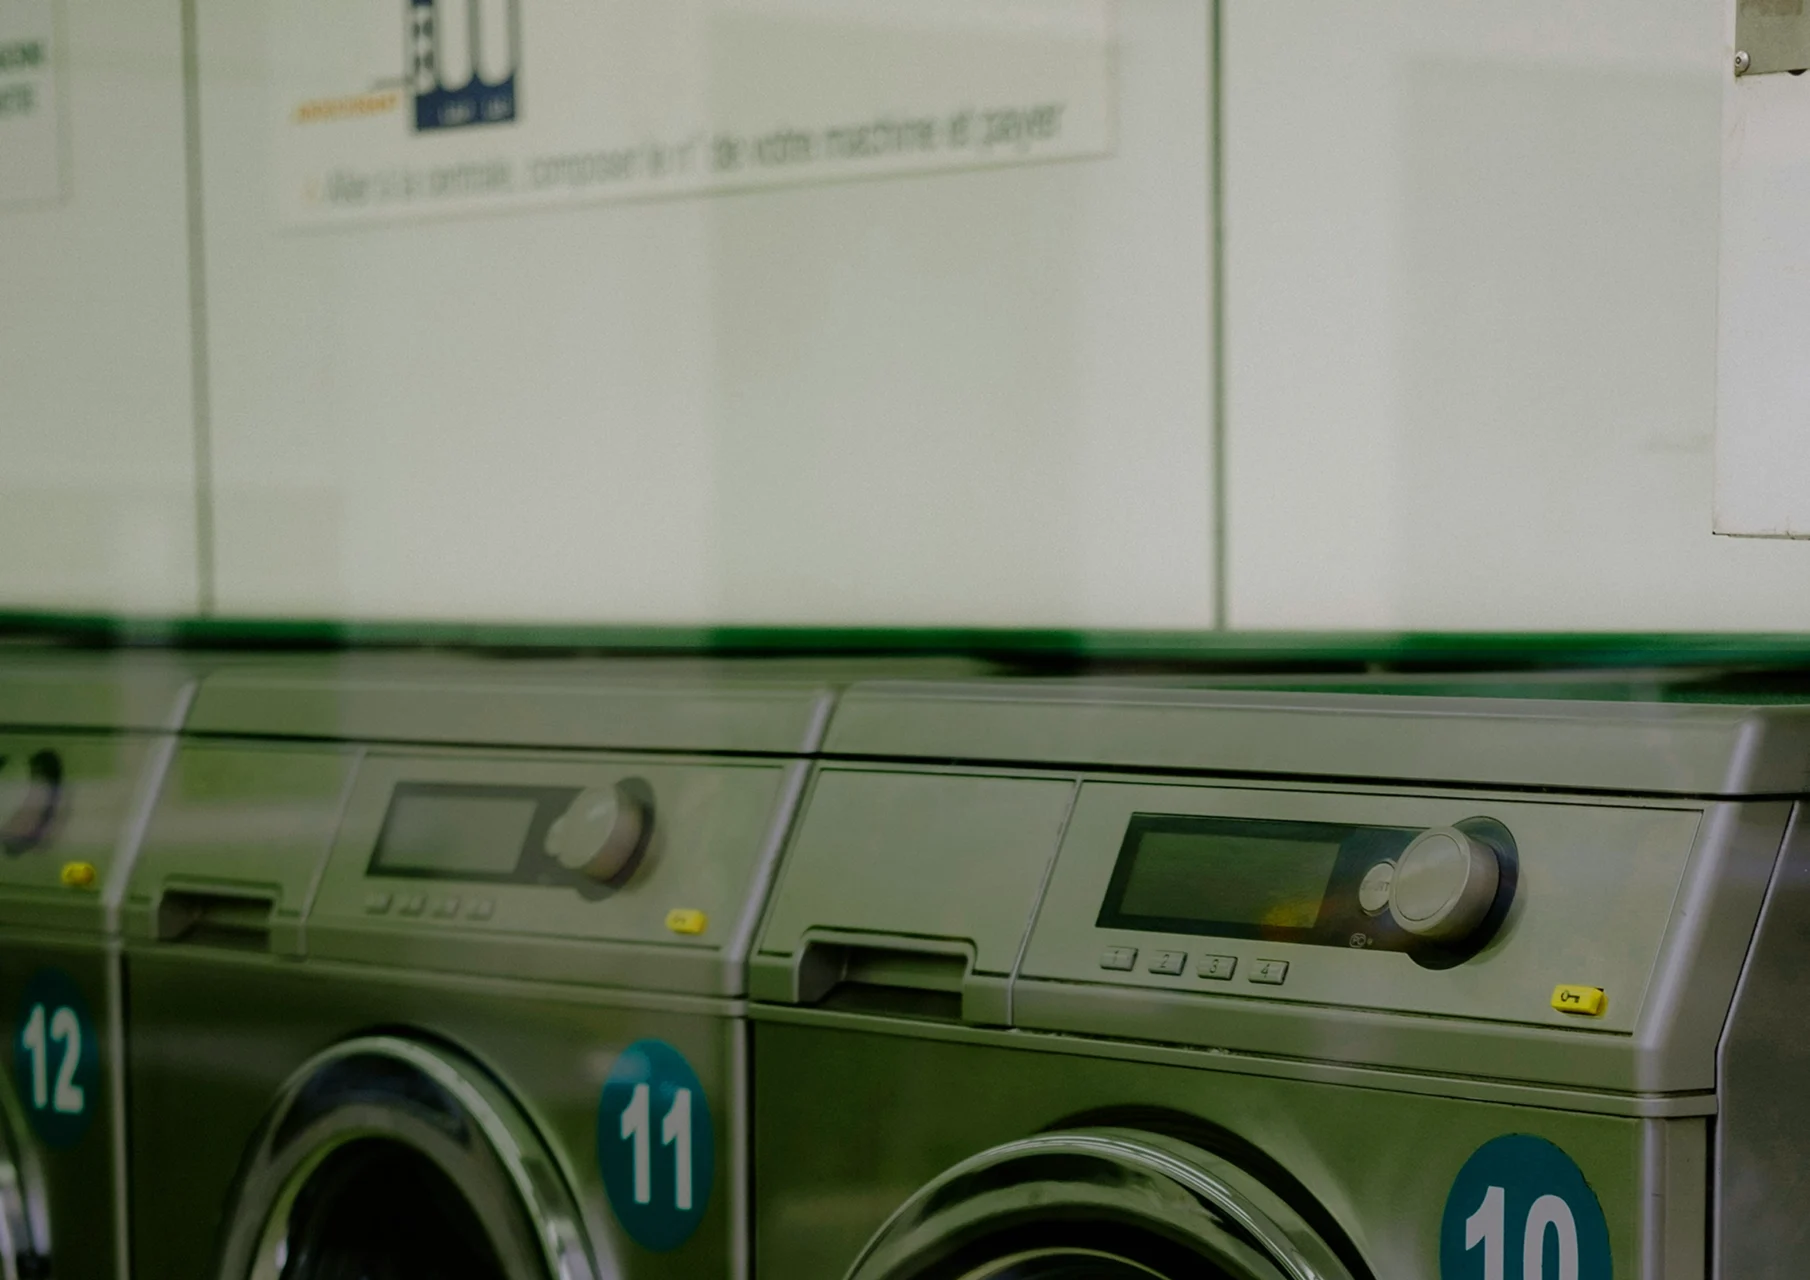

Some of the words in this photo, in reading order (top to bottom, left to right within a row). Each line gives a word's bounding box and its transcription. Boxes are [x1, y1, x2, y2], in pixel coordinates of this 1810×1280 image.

[1209, 958, 1219, 974] 3
[1260, 963, 1269, 978] 4
[23, 1003, 84, 1112] 12
[621, 1083, 692, 1210] 11
